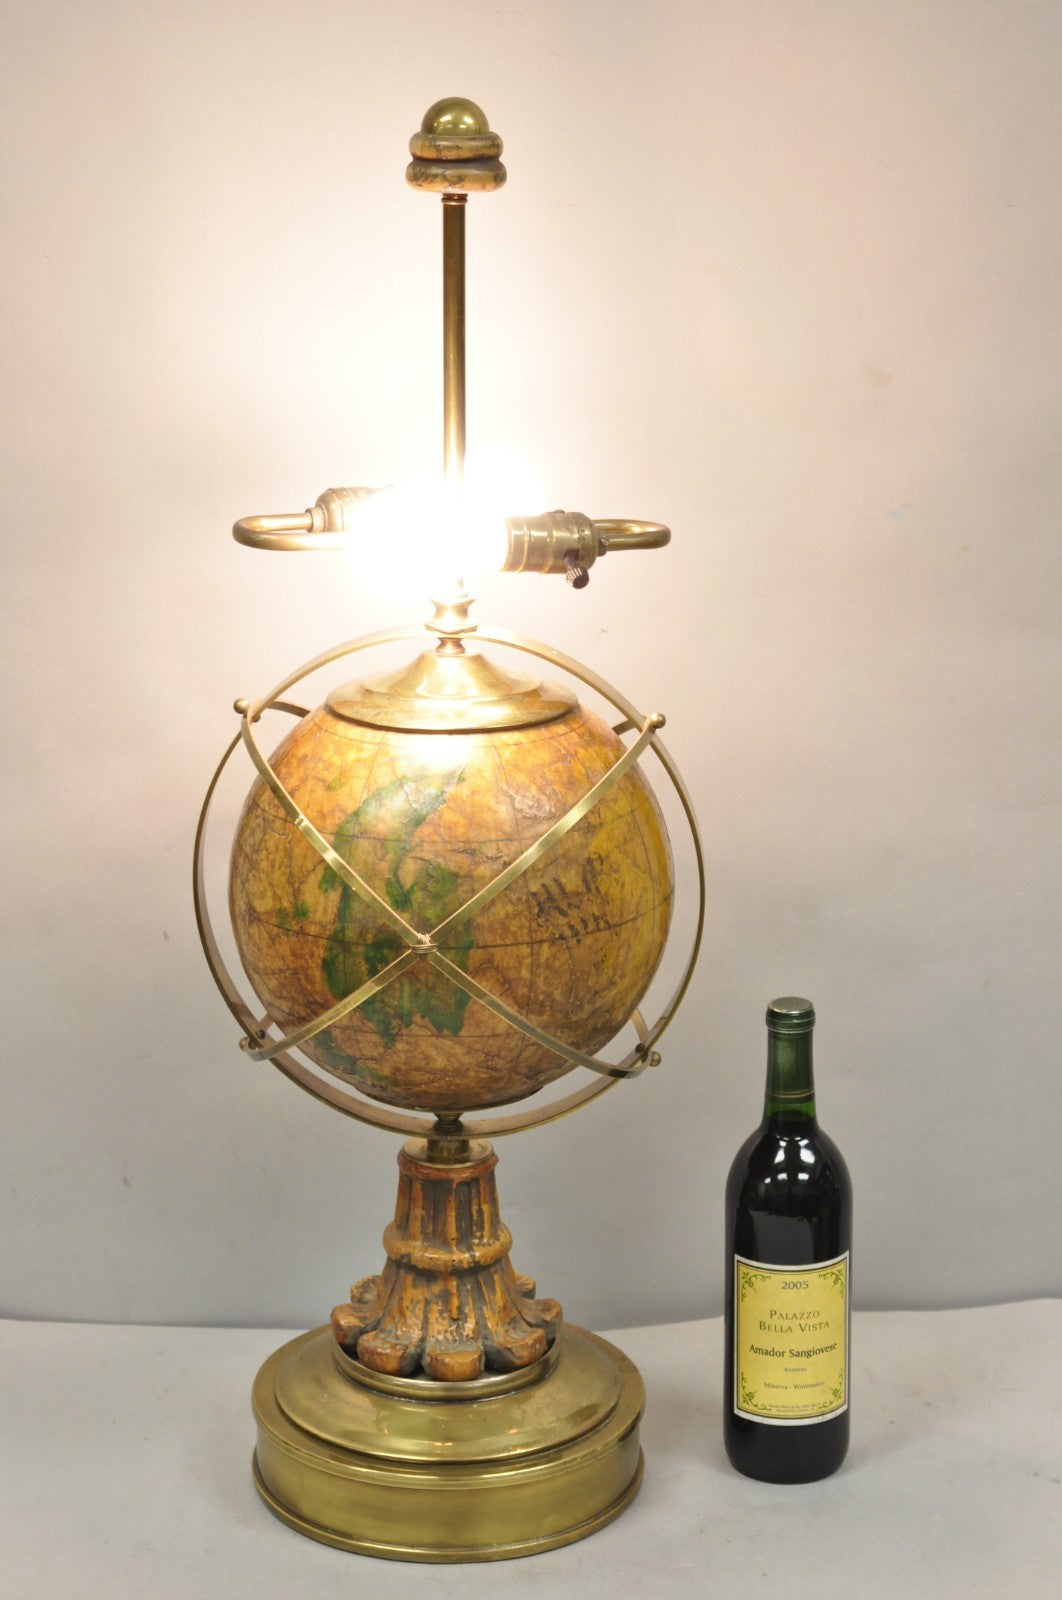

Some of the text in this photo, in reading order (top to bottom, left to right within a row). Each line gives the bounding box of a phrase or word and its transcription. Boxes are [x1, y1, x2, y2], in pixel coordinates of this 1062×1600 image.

[781, 1280, 809, 1290] 2005
[769, 1309, 821, 1321] PALAZZO
[759, 1320, 830, 1334] BELLA VISTA
[749, 1343, 837, 1359] Amador Sangiovese
